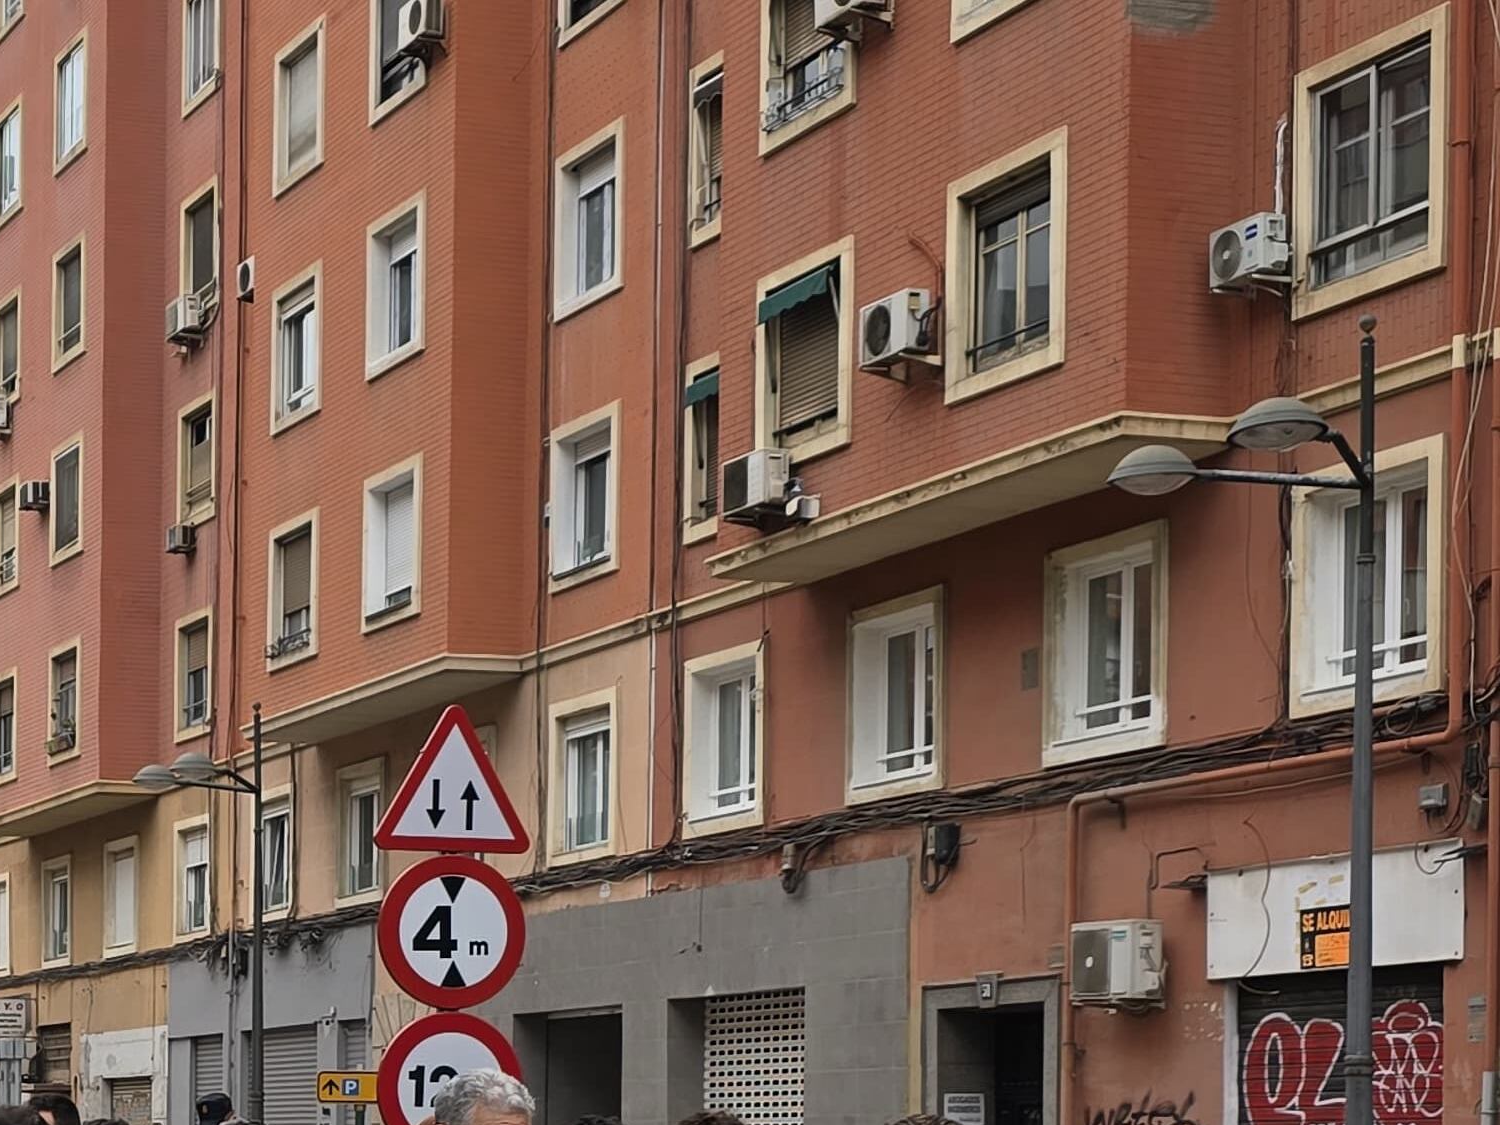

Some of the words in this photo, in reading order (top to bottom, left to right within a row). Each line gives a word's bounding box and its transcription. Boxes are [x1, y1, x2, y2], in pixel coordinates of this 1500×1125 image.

[412, 905, 458, 959] 4
[468, 938, 490, 956] m
[1302, 913, 1315, 933] SE
[344, 1081, 357, 1095] P
